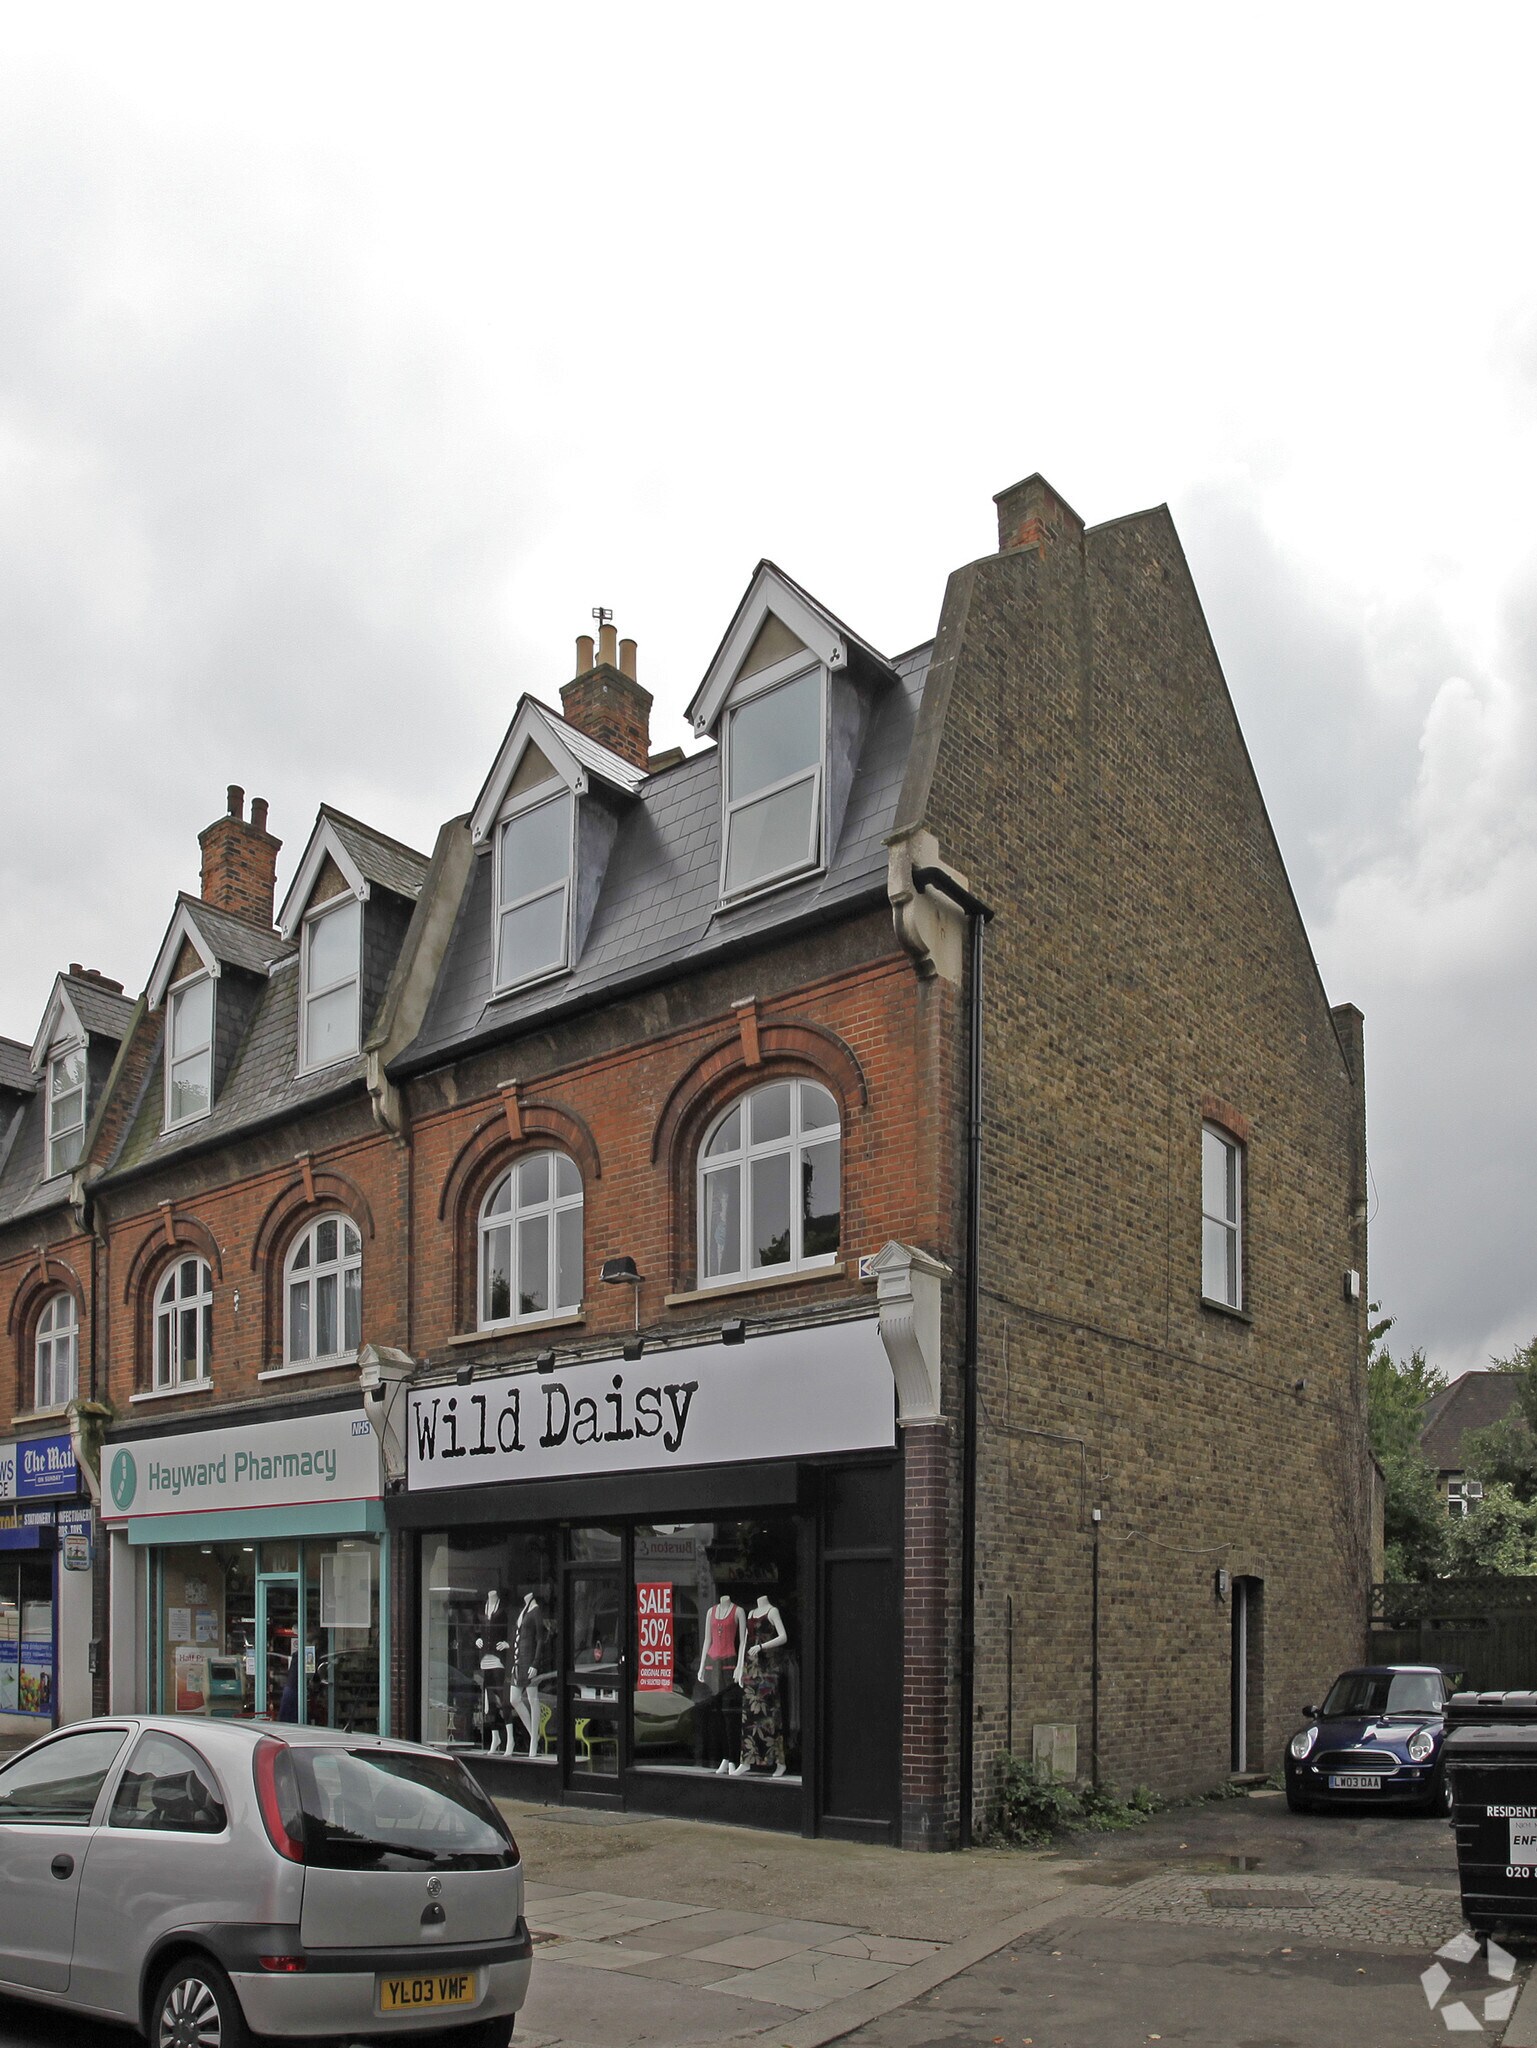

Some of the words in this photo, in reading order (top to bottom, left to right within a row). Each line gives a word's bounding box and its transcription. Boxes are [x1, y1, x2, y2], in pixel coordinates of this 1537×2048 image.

[413, 1388, 525, 1460] Wild
[539, 1374, 698, 1452] Daisy
[352, 1421, 369, 1435] NHS
[24, 1450, 45, 1474] The
[47, 1443, 76, 1470] Mail
[45, 1474, 61, 1482] SUNDAY
[149, 1453, 226, 1495] Hayward
[234, 1449, 336, 1482] Pharmacy
[24, 1513, 51, 1525] STATIONERY
[639, 1589, 671, 1614] SALE
[640, 1618, 671, 1647] 50%
[640, 1650, 671, 1666] OFF
[640, 1668, 659, 1676] ORIGINAL
[660, 1669, 671, 1677] PRICE
[1486, 1805, 1537, 1818] RESIDENT
[1513, 1835, 1537, 1846] ENF
[1505, 1866, 1530, 1878] 020
[389, 1980, 433, 2004] YL03
[438, 1976, 468, 2000] VMF
